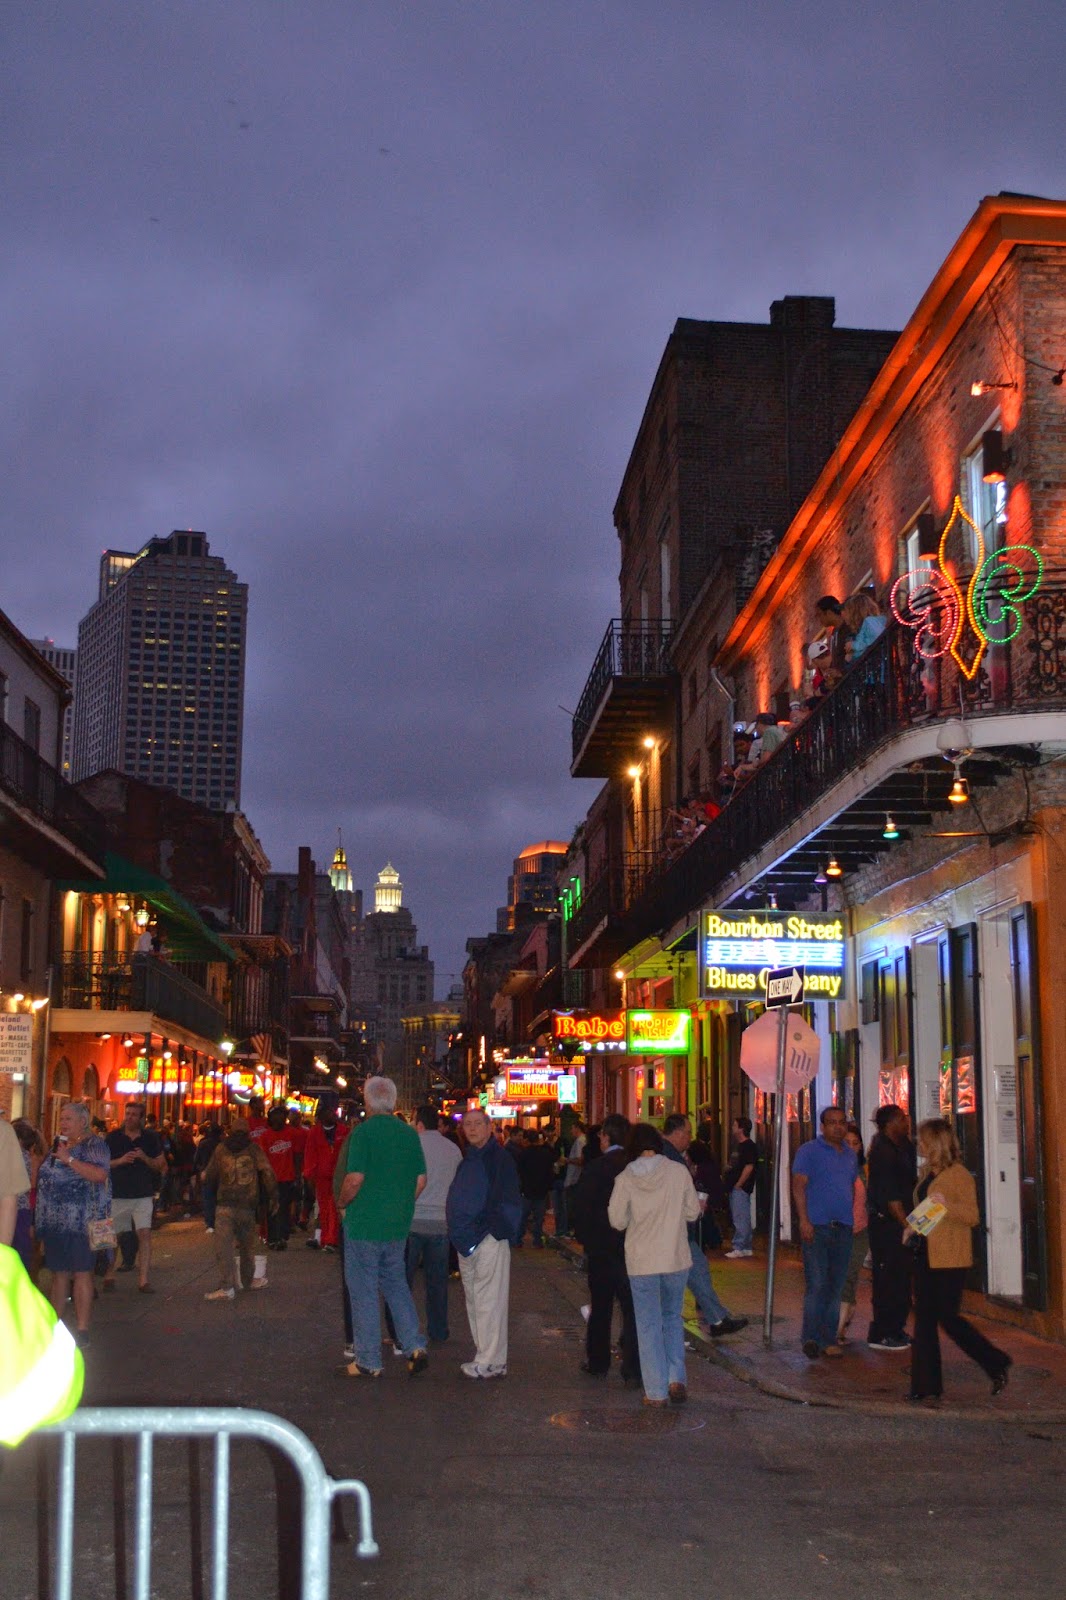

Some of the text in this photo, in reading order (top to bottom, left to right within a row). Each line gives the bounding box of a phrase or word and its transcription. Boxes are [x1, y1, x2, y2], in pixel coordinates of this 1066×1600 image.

[706, 914, 843, 940] Bourbon Street
[706, 966, 757, 989] Blues
[770, 978, 793, 996] ONE WAY
[8, 1024, 30, 1032] Outlet
[556, 1011, 626, 1037] Babe'
[632, 1018, 678, 1029] TROPICA
[509, 1082, 531, 1095] BARELY
[532, 1082, 548, 1095] LEGAL
